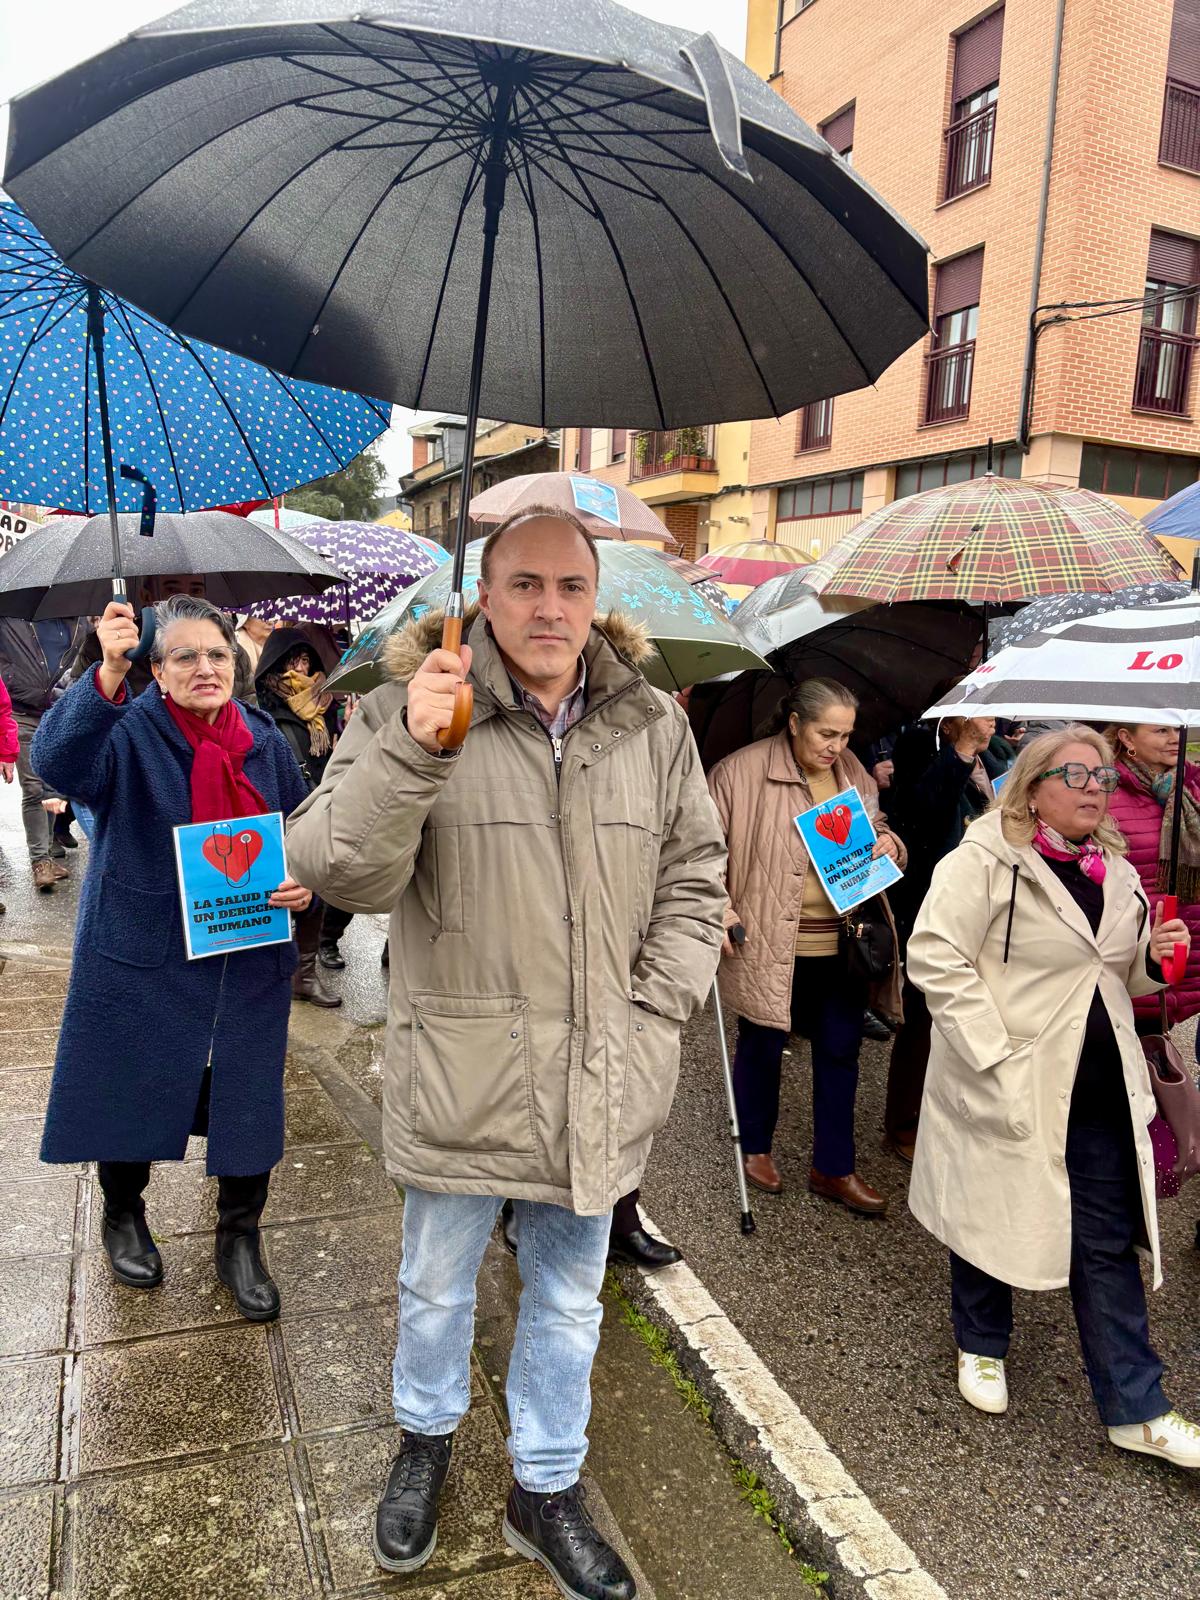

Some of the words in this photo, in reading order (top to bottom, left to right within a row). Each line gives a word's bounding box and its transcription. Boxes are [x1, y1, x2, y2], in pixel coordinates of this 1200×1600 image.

[1127, 651, 1184, 670] Lo
[823, 863, 836, 874] LA
[836, 848, 863, 867] SALUD
[827, 873, 841, 885] UN
[840, 865, 880, 891] HUMANO
[194, 899, 212, 910] LA
[215, 891, 261, 907] SALUD
[264, 889, 278, 899] E
[193, 911, 215, 923] UN
[207, 915, 272, 934] HUMANO
